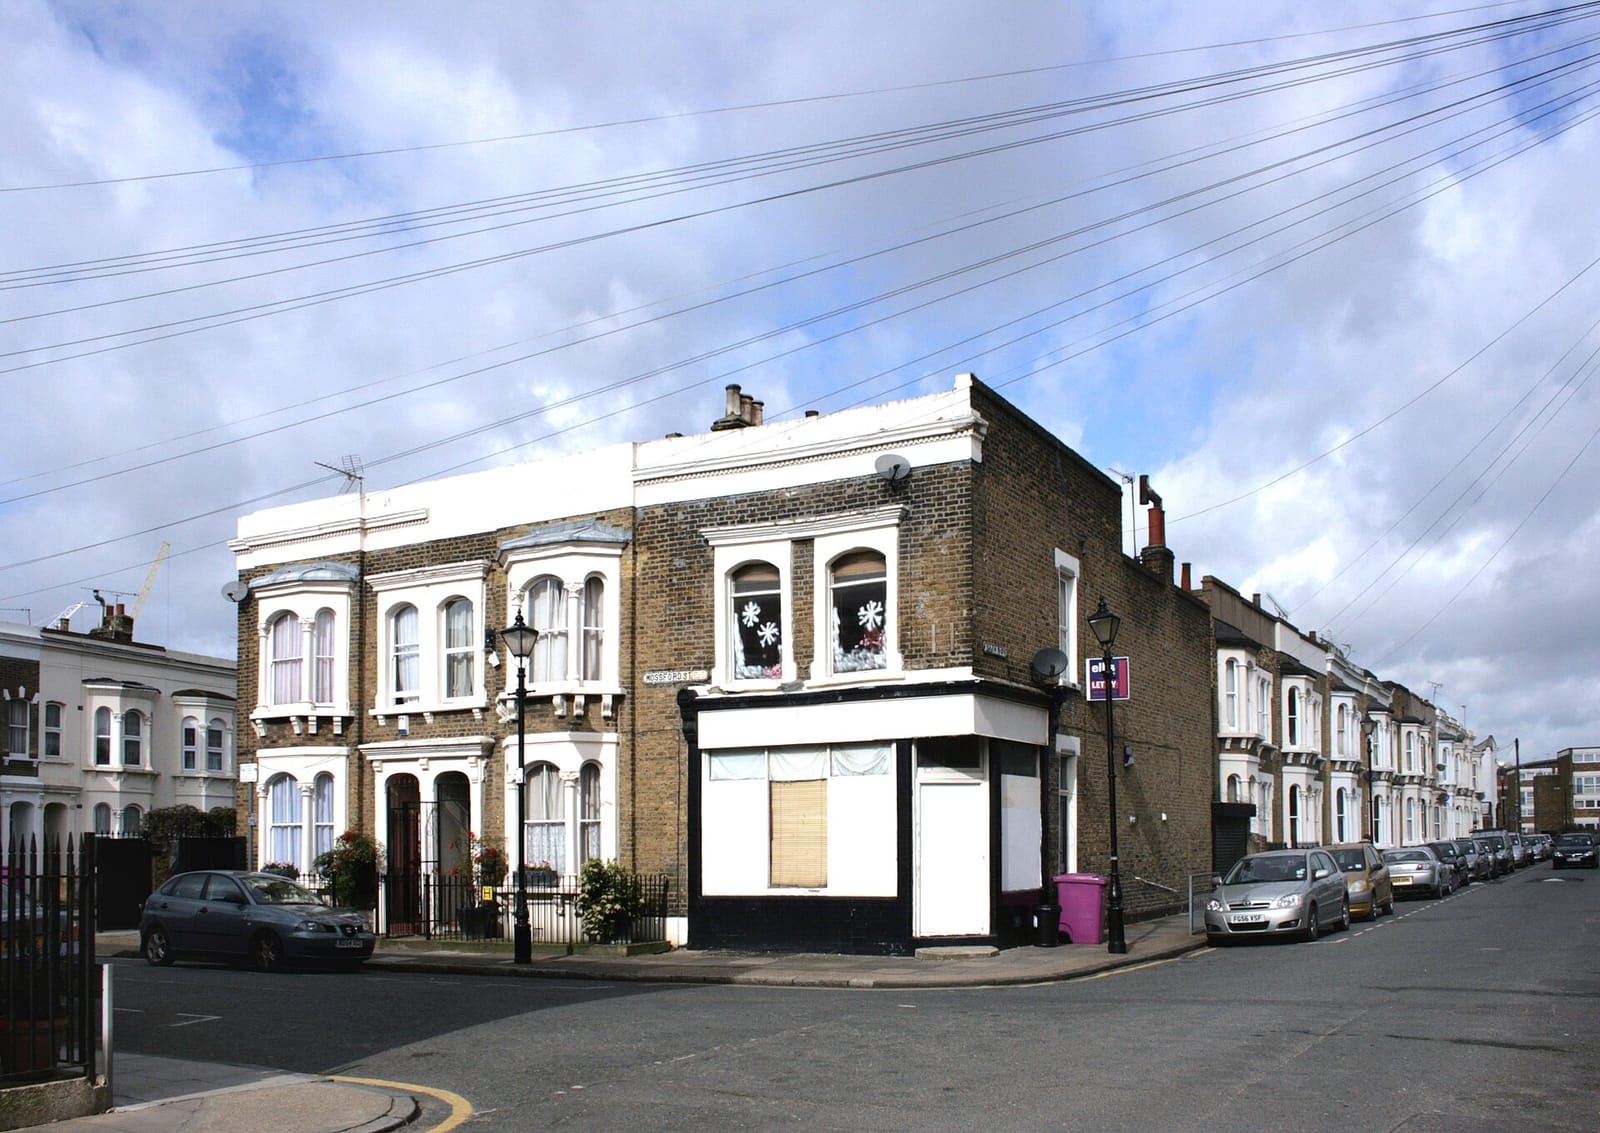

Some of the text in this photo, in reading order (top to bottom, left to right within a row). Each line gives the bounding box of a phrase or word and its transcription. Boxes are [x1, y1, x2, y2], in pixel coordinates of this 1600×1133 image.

[1092, 662, 1116, 672] ells
[1092, 680, 1105, 689] LET
[484, 888, 490, 898] H
